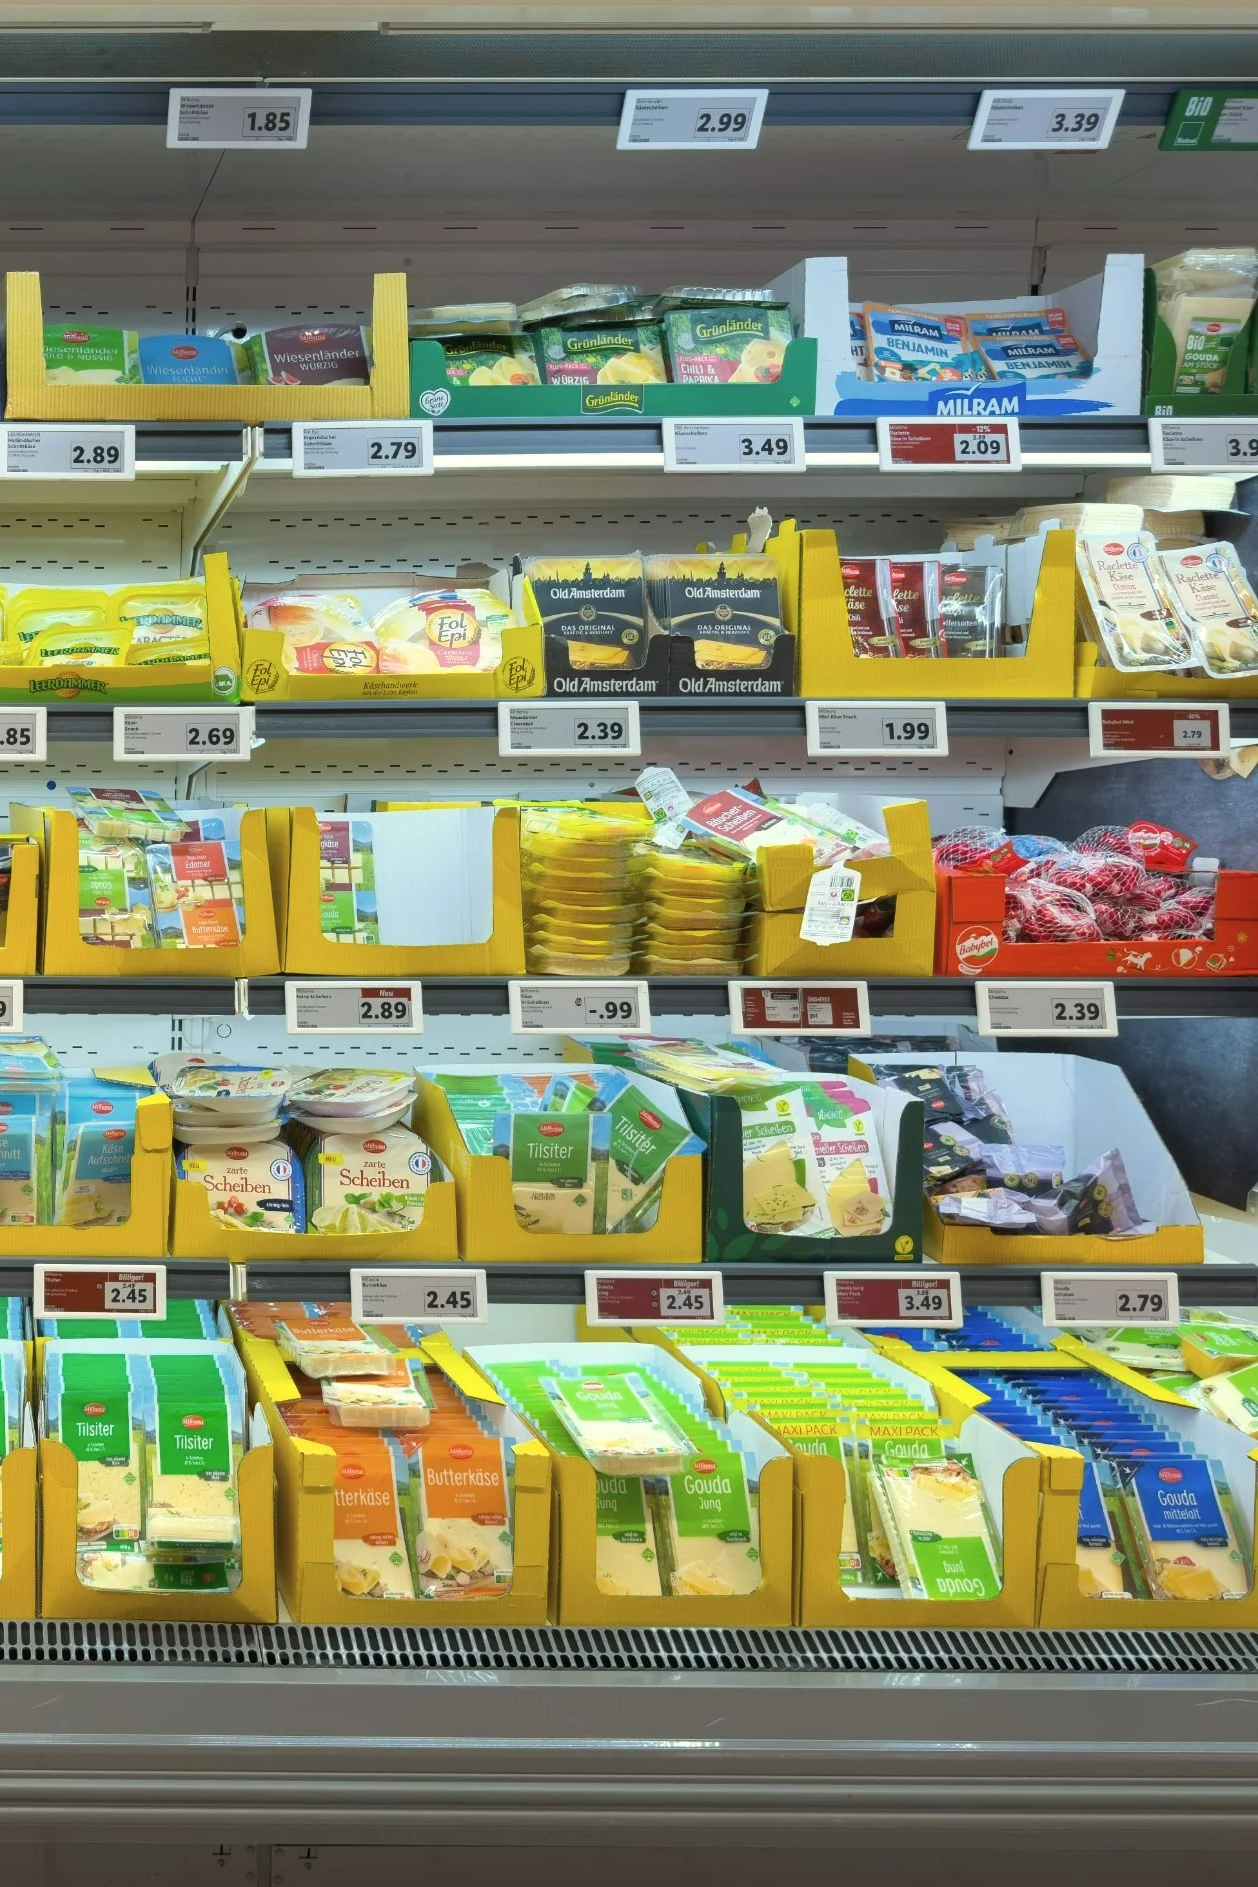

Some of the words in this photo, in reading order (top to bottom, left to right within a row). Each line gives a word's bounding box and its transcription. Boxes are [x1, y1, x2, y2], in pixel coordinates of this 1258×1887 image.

[1185, 96, 1211, 117] BiO
[247, 111, 291, 132] 1.85
[697, 112, 747, 133] 2.99
[1051, 112, 1100, 133] 3.39
[696, 321, 764, 339] Grünländer
[893, 321, 940, 338] MILRAM
[445, 341, 507, 355] Grünländer
[567, 334, 634, 351] Grünländer
[887, 338, 949, 359] BENJAMIN
[1187, 333, 1203, 350] BiO
[274, 348, 360, 363] Wiesenländer
[1007, 346, 1057, 357] MILRAM
[1186, 353, 1219, 362] GOUDA
[147, 365, 229, 375] Wiesenländer
[300, 359, 338, 371] WÜRZIG
[681, 364, 703, 374] CHILI
[707, 364, 715, 374] &
[1004, 359, 1072, 372] BENJAMIN
[552, 374, 589, 385] WÜRZIG
[585, 391, 640, 407] Grünländer
[936, 396, 1020, 416] MILRAM
[72, 445, 120, 464] 2.89
[370, 441, 417, 460] 2.79
[742, 438, 789, 456] 3.49
[960, 440, 1001, 455] 2.09
[1098, 560, 1138, 572] Raclette
[1110, 571, 1134, 583] Käse
[1177, 572, 1220, 585] Raclette
[551, 588, 568, 599] Old
[570, 588, 625, 599] Amsterdam
[685, 588, 702, 598] Old
[704, 588, 760, 599] Amsterdam
[1189, 583, 1216, 595] Käse
[438, 613, 467, 632] Fol
[438, 629, 467, 649] Epi
[40, 646, 120, 657] LEERDAMMER
[509, 659, 525, 675] Fol
[29, 679, 107, 694] LEERDAMMER
[363, 681, 417, 690] Käsehandwerk
[509, 673, 527, 692] Epi
[554, 677, 578, 692] Old
[580, 677, 657, 692] Amsterdam
[679, 677, 703, 693] Old
[705, 678, 782, 693] Amsterdam
[188, 727, 235, 745] 2.69
[577, 722, 623, 739] 2.39
[885, 722, 930, 740] 1.99
[1182, 729, 1202, 739] 2.79
[706, 804, 743, 827] Räucher-
[721, 809, 755, 832] Scheiben
[186, 860, 210, 868] Edamer
[192, 924, 228, 933] Butterkäse
[959, 938, 994, 955] Babybel
[380, 989, 393, 997] Neu
[361, 1002, 406, 1019] 2.89
[589, 1002, 632, 1019] -.99
[1054, 1003, 1099, 1020] 2.39
[615, 1116, 656, 1155] Tilsiter
[756, 1125, 792, 1136] Scheiben
[527, 1143, 574, 1159] Tilsiter
[204, 1176, 271, 1193] Scheiben
[340, 1169, 409, 1189] Scheiben
[119, 1273, 144, 1281] Billiger!
[673, 1279, 700, 1288] Billiger!
[910, 1280, 937, 1288] Billiger!
[110, 1288, 147, 1303] 2.45
[426, 1291, 471, 1309] 2.45
[666, 1294, 704, 1310] 2.45
[904, 1295, 943, 1311] 3.49
[1118, 1293, 1162, 1313] 2.79
[76, 1422, 114, 1437] Tilsiter
[870, 1426, 902, 1436] MAXI
[905, 1426, 938, 1436] PACK
[174, 1435, 213, 1450] Tilsiter
[886, 1441, 928, 1457] Gouda
[428, 1469, 499, 1485] Butterkäse
[684, 1475, 731, 1494] Gouda
[699, 1497, 721, 1512] Jung
[1158, 1490, 1197, 1506] Gouda
[1163, 1508, 1201, 1520] mittelalt
[944, 1560, 964, 1573] Jung
[937, 1578, 985, 1596] Gouda
